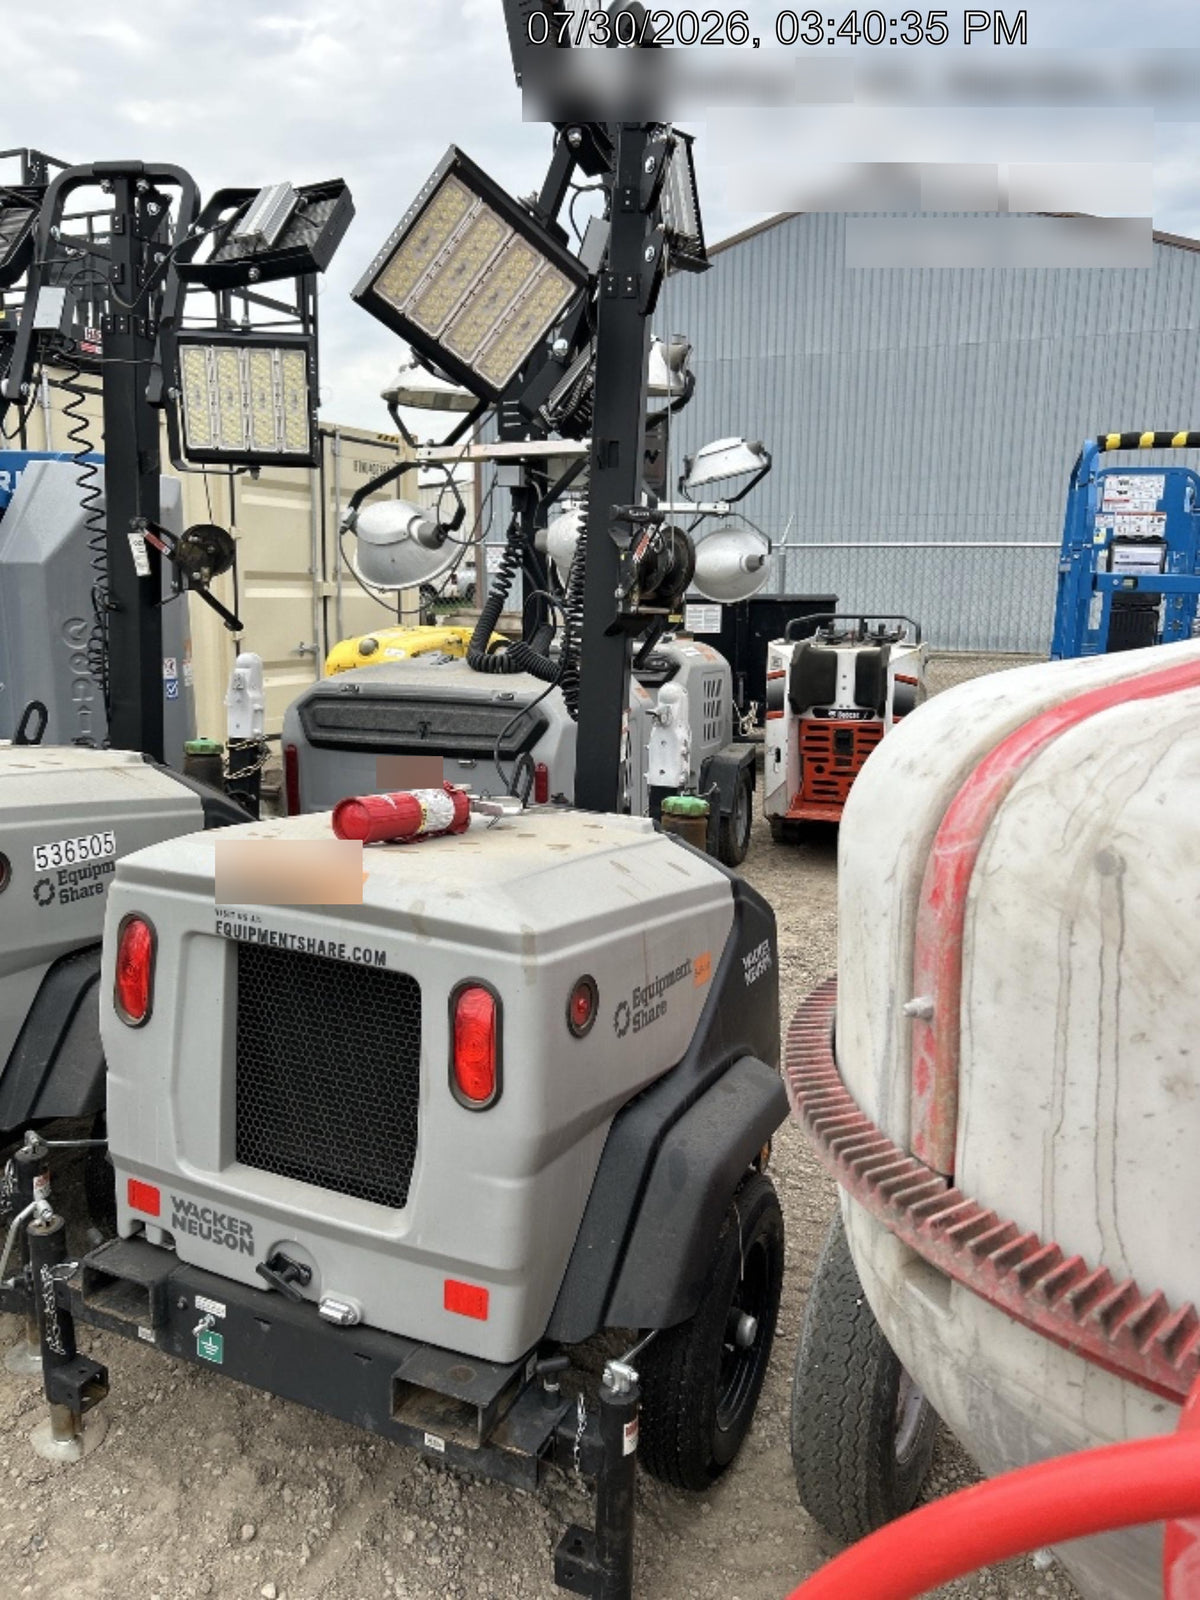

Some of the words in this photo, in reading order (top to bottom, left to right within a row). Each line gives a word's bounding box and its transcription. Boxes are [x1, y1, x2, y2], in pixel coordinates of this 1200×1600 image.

[36, 833, 114, 868] 536505
[59, 882, 104, 905] Share
[216, 920, 388, 967] EQUIPMENTSHARE.COM
[632, 957, 692, 1010] Equipment
[632, 1000, 668, 1034] Share
[170, 1194, 254, 1240] WACKER
[171, 1212, 255, 1257] NEUSON
